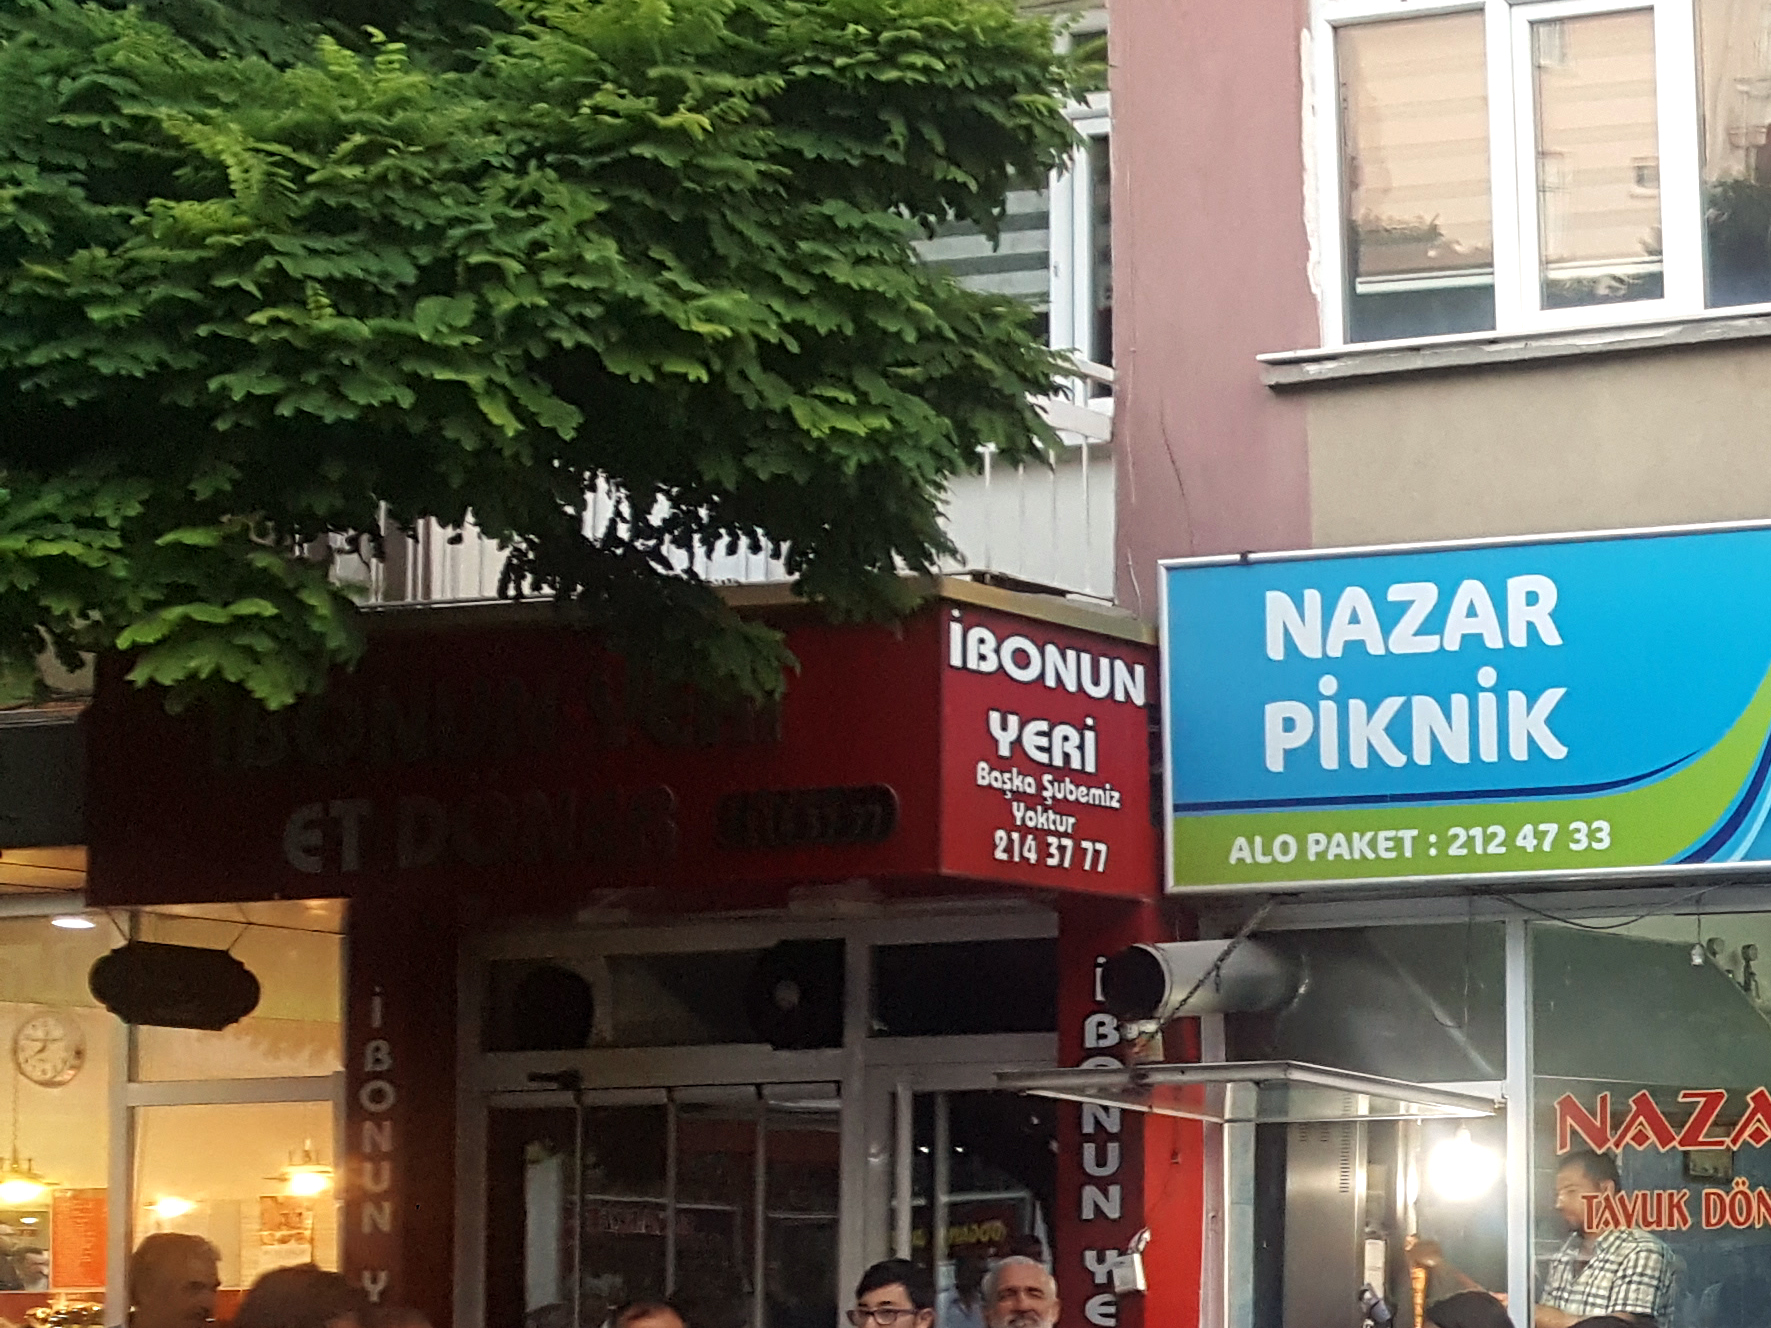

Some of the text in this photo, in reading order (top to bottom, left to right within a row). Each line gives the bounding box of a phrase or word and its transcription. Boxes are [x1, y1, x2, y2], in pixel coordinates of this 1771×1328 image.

[1265, 574, 1563, 661] NAZAR
[948, 608, 1146, 707] İBONUN
[987, 708, 1097, 774] YERİ
[1264, 666, 1569, 772] PİKNİK
[976, 760, 1121, 809] Başka Şubemiz
[282, 799, 375, 874] ET
[1011, 801, 1077, 833] Yoktur
[1229, 834, 1297, 865] ALO
[1307, 829, 1418, 861] PAKET
[1447, 824, 1507, 857] 212
[1515, 822, 1559, 853] 47
[1568, 820, 1611, 851] 33
[993, 828, 1108, 873] 214 37 77
[1581, 1188, 1692, 1233] TAVUK
